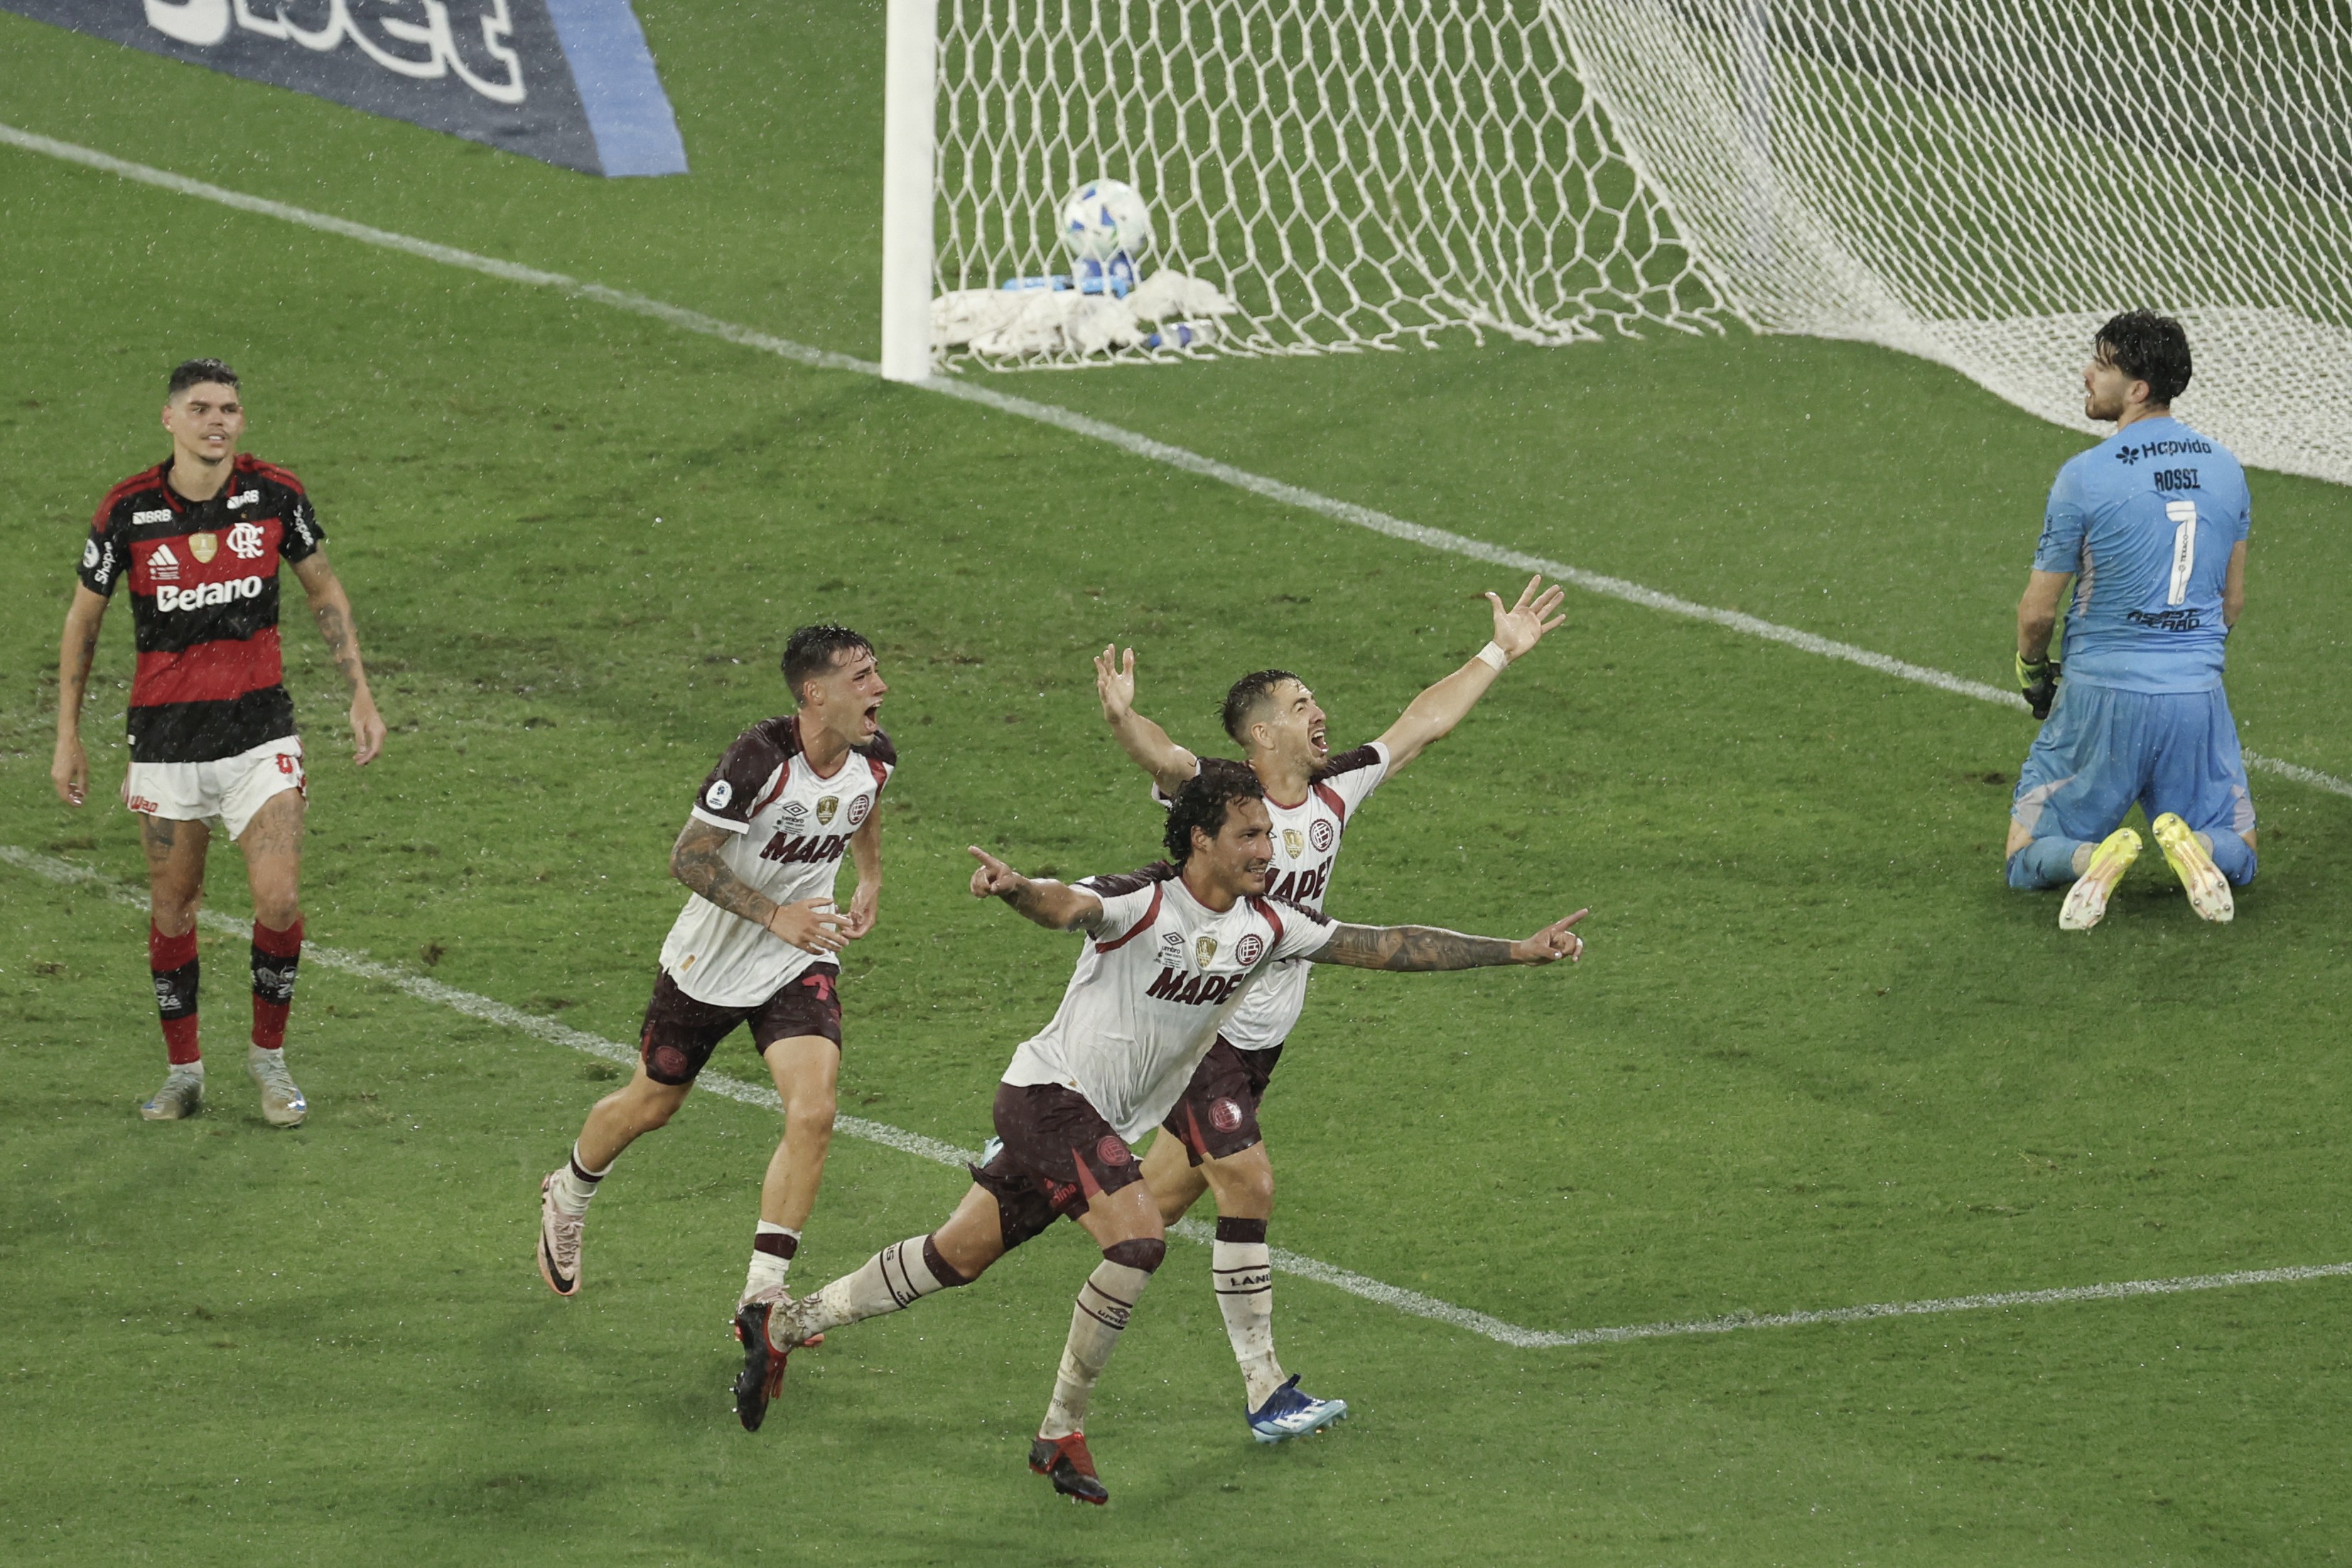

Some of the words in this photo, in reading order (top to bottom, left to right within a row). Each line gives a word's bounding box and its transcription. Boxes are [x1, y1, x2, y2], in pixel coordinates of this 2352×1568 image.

[2141, 438, 2212, 458] Hapvida
[2153, 468, 2201, 492] ROSSI
[145, 509, 171, 523] BRB
[156, 575, 263, 612] Betano
[1161, 945, 1181, 954] umbro
[1145, 966, 1249, 1006] MAPE
